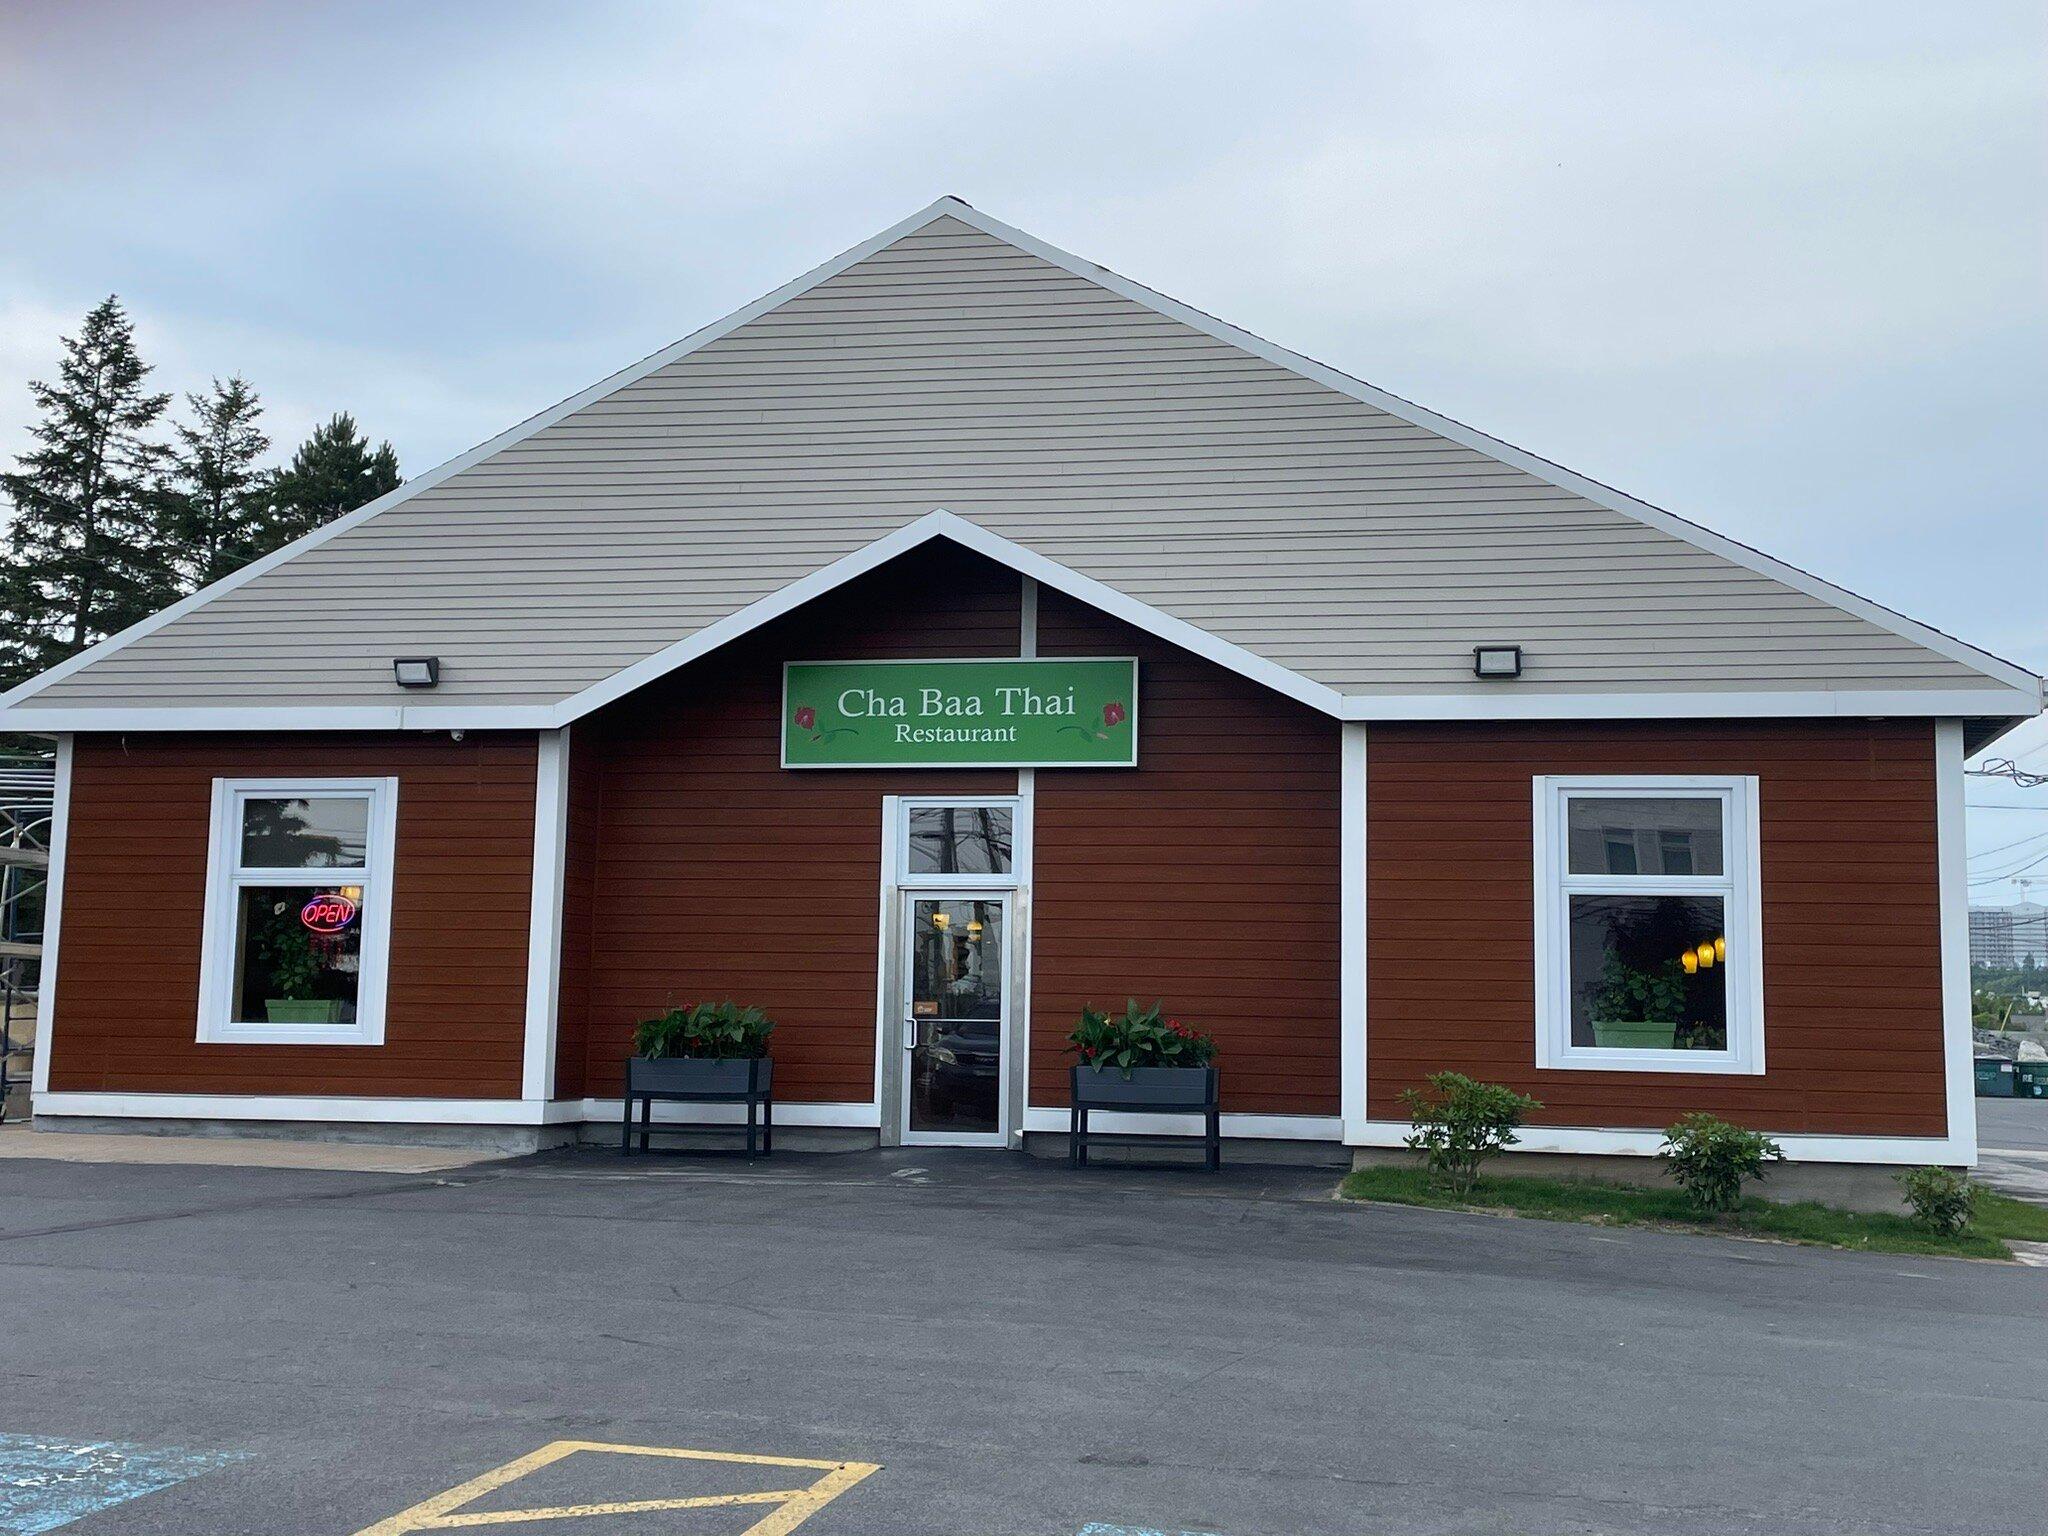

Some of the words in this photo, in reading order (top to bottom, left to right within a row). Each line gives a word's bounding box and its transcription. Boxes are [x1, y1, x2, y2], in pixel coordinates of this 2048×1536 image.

[838, 688, 907, 718] Cha
[919, 688, 984, 717] Baa
[995, 686, 1076, 716] Thai
[894, 723, 1017, 743] Restaurant
[304, 904, 350, 922] OPEN
